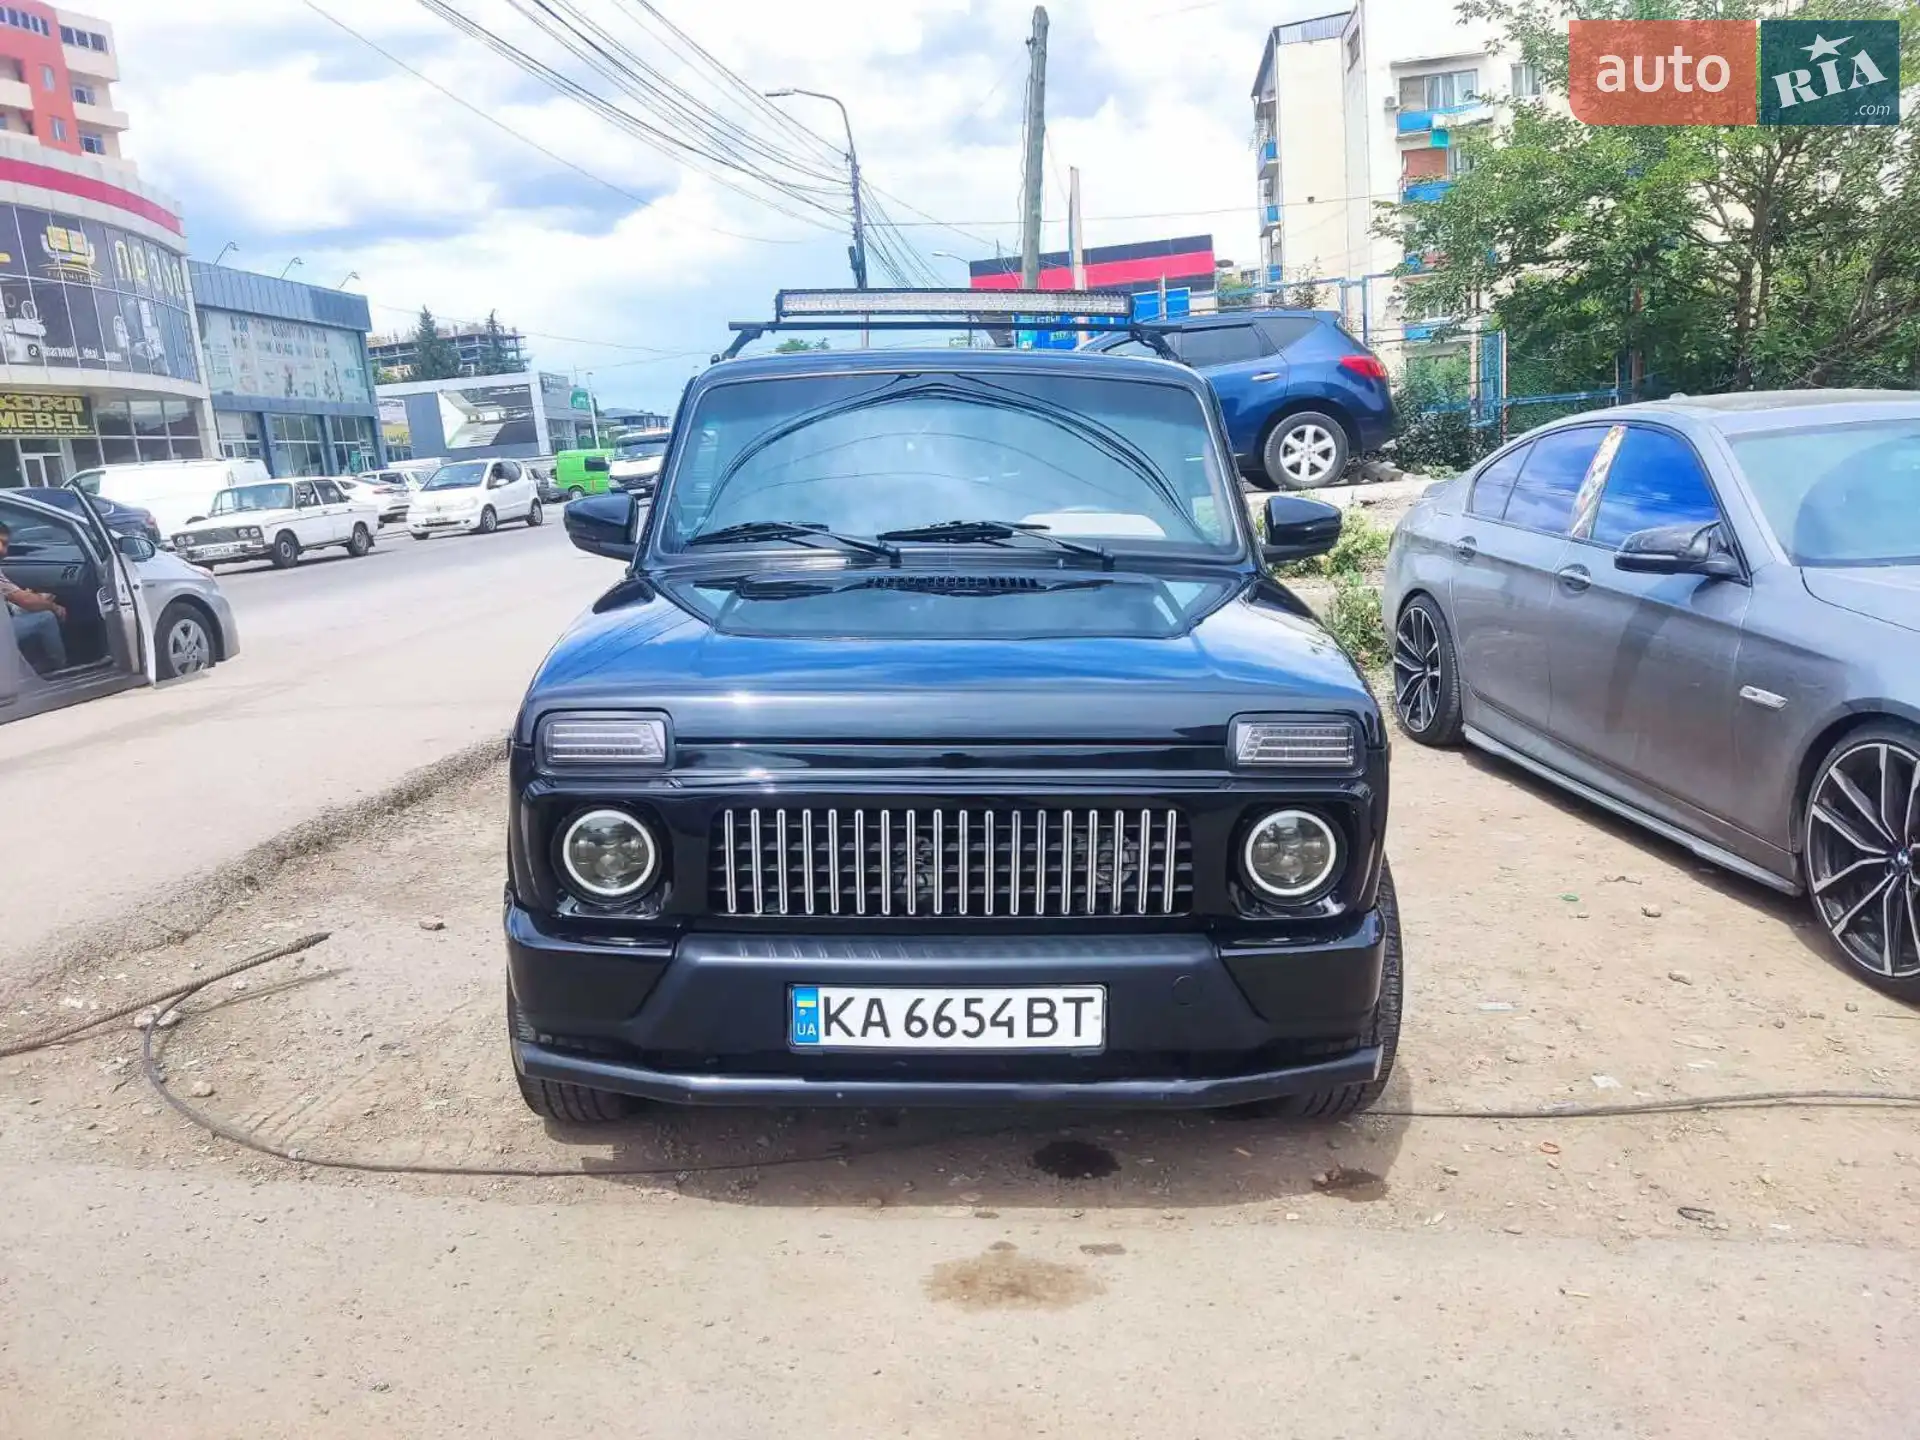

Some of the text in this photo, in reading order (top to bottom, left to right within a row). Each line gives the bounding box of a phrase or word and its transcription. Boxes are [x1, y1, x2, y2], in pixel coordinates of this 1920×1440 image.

[0, 411, 89, 429] MEBEL
[823, 996, 1096, 1039] KA 6654 BT
[796, 1022, 817, 1036] UA
